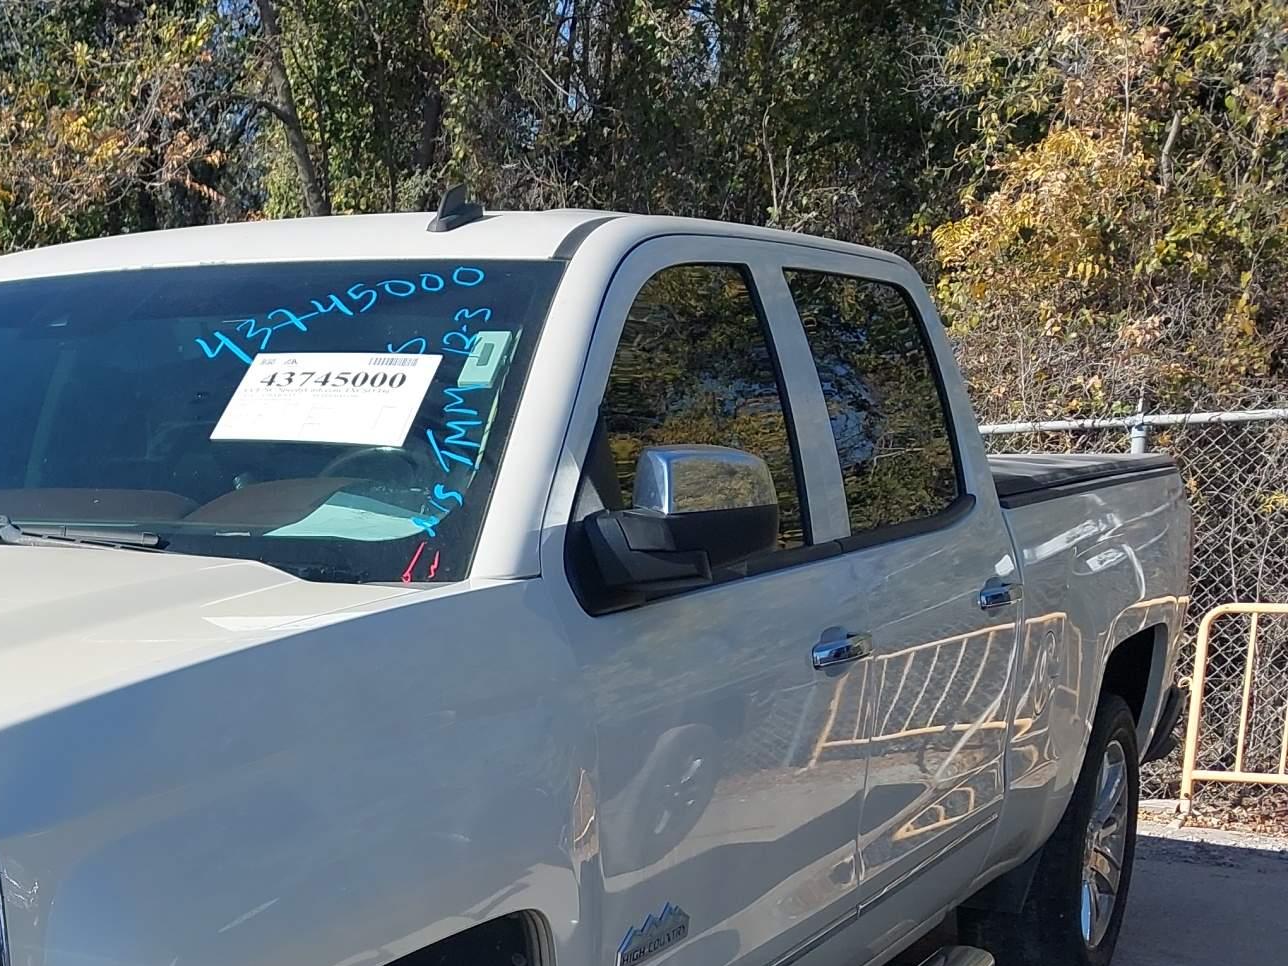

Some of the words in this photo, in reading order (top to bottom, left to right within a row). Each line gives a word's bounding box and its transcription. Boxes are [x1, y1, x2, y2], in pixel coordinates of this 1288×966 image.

[194, 265, 486, 366] 43745000
[259, 371, 408, 389] 43745000
[621, 947, 646, 966] HIGH
[647, 923, 687, 953] COUNTRY
